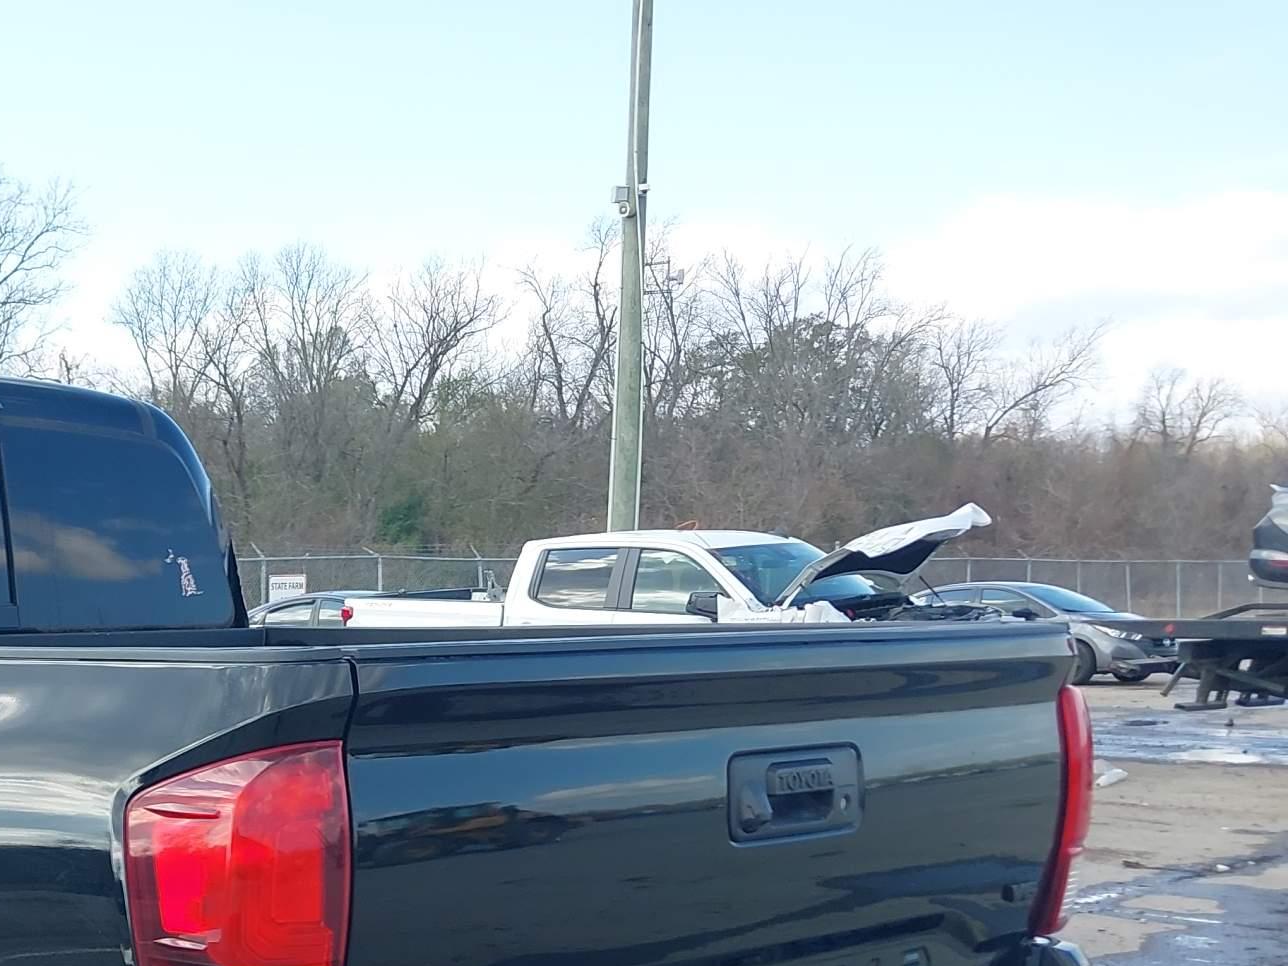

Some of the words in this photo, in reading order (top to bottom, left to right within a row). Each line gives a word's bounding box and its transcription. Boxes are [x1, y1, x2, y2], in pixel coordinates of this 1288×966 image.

[271, 582, 288, 591] STATE
[289, 581, 304, 590] FARM
[775, 767, 833, 793] TOYOTA
